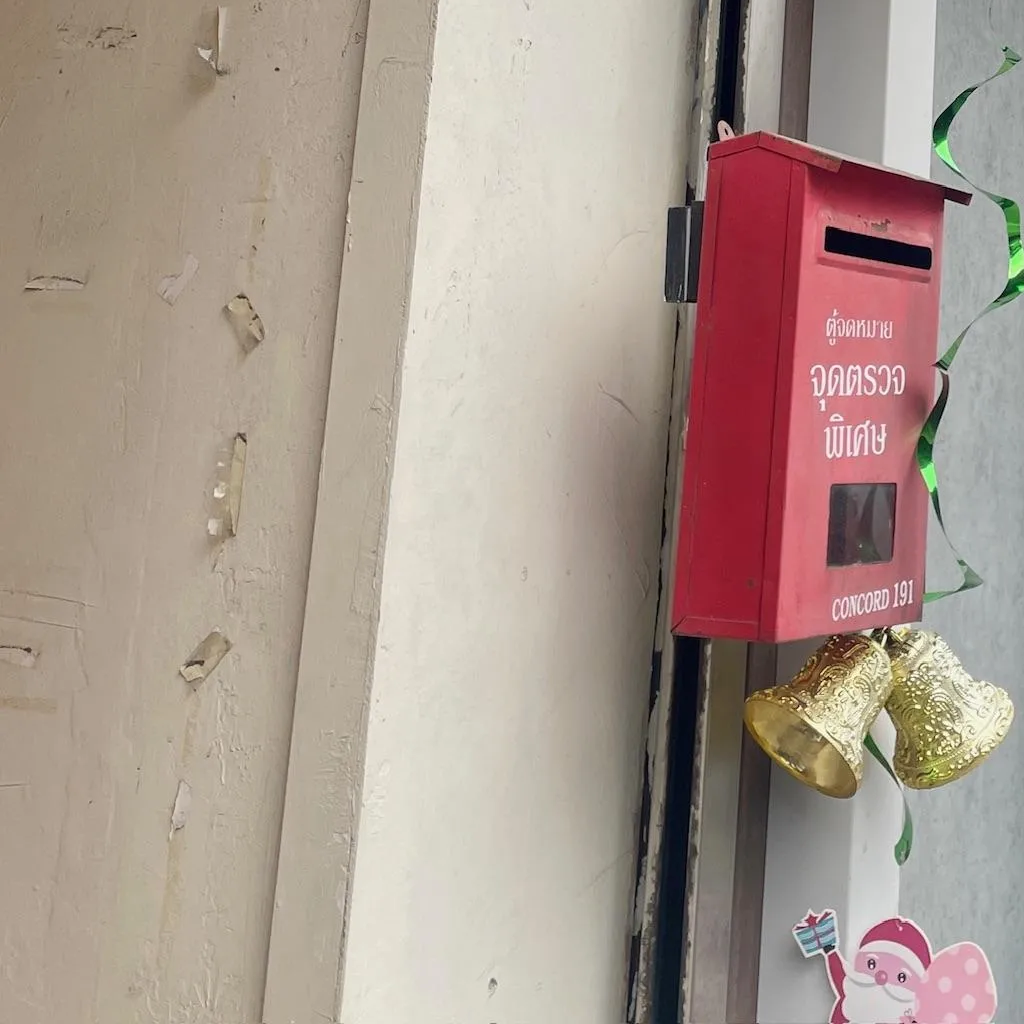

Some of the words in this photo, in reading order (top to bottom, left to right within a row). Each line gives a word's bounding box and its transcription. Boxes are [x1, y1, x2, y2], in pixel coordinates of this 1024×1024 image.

[826, 308, 894, 346] ตู้จดหมาย
[810, 364, 906, 412] จุดตรวจ
[824, 413, 887, 459] พิเศษ
[832, 588, 890, 622] CONCORD
[892, 579, 914, 608] 191
